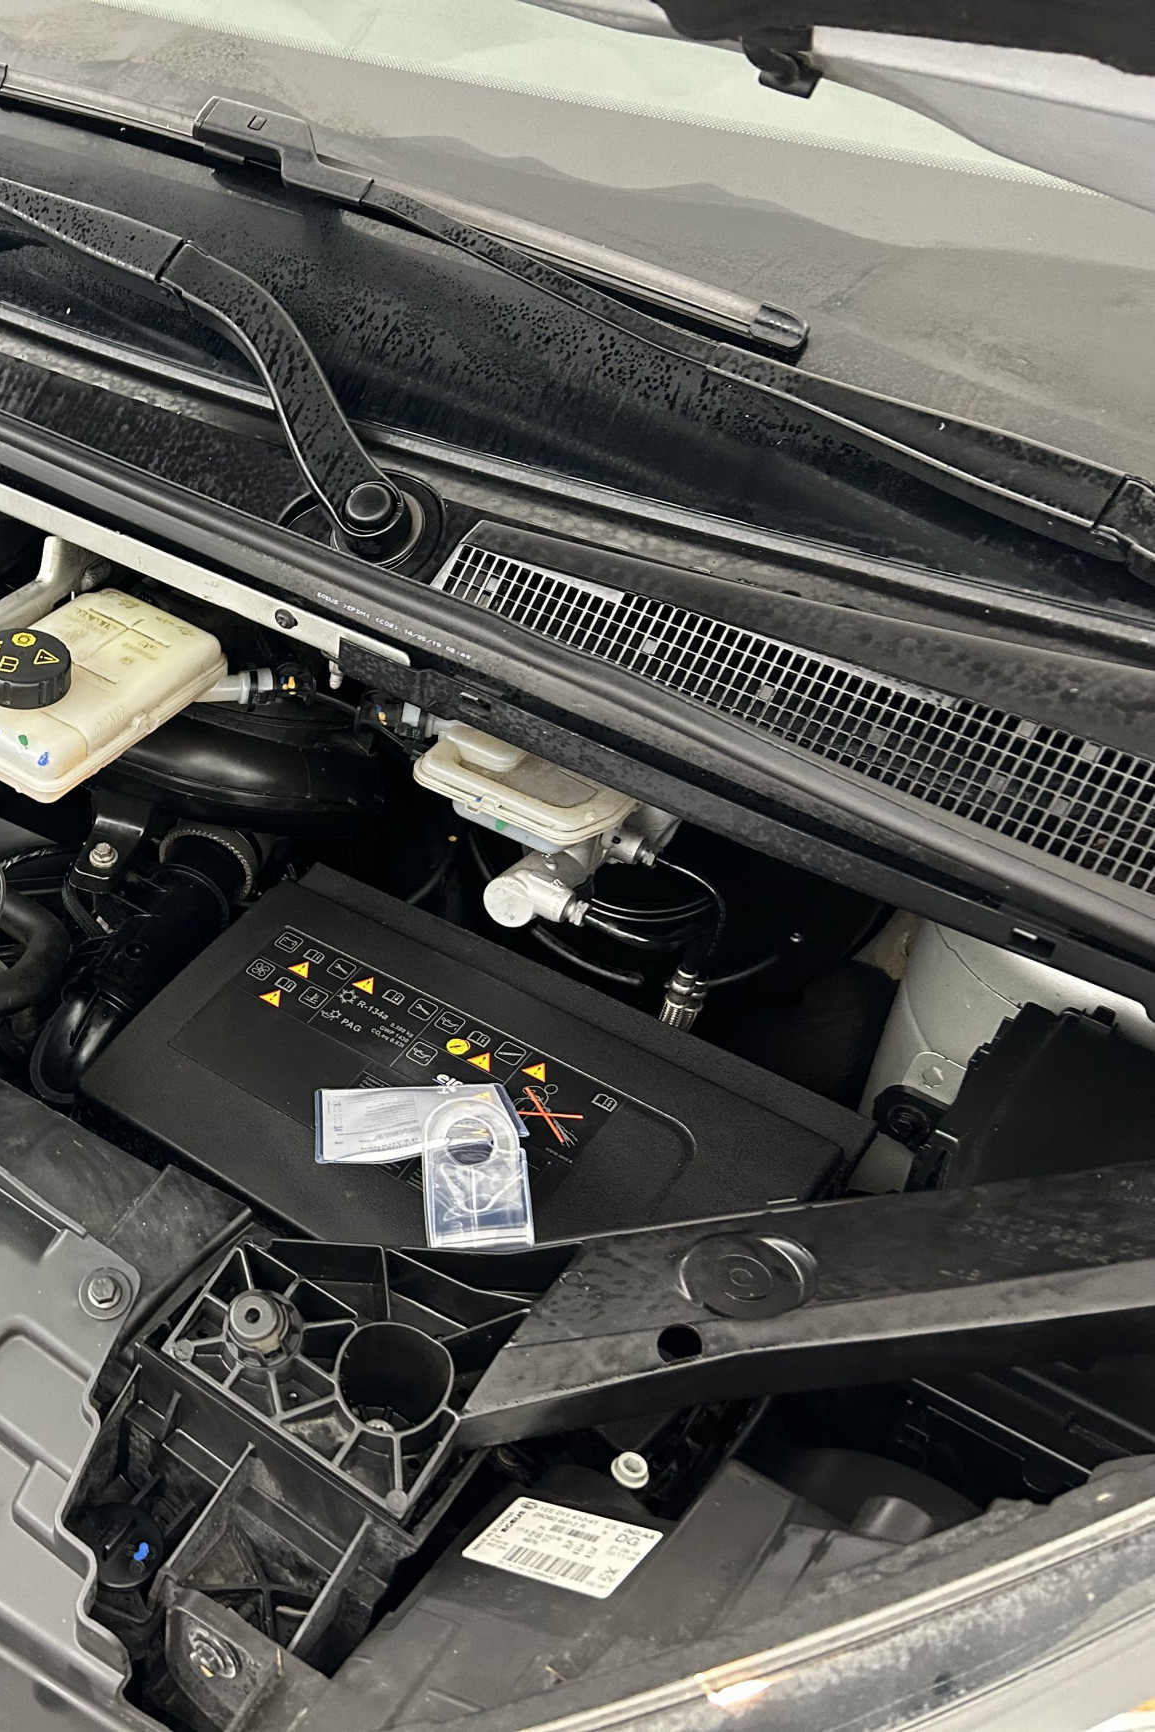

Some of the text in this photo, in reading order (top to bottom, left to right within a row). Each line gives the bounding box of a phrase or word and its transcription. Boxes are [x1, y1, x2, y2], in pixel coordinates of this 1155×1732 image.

[356, 1000, 388, 1020] R-134a
[340, 1018, 362, 1032] PAG
[380, 1026, 395, 1034] GWP
[614, 1532, 640, 1546] DG
